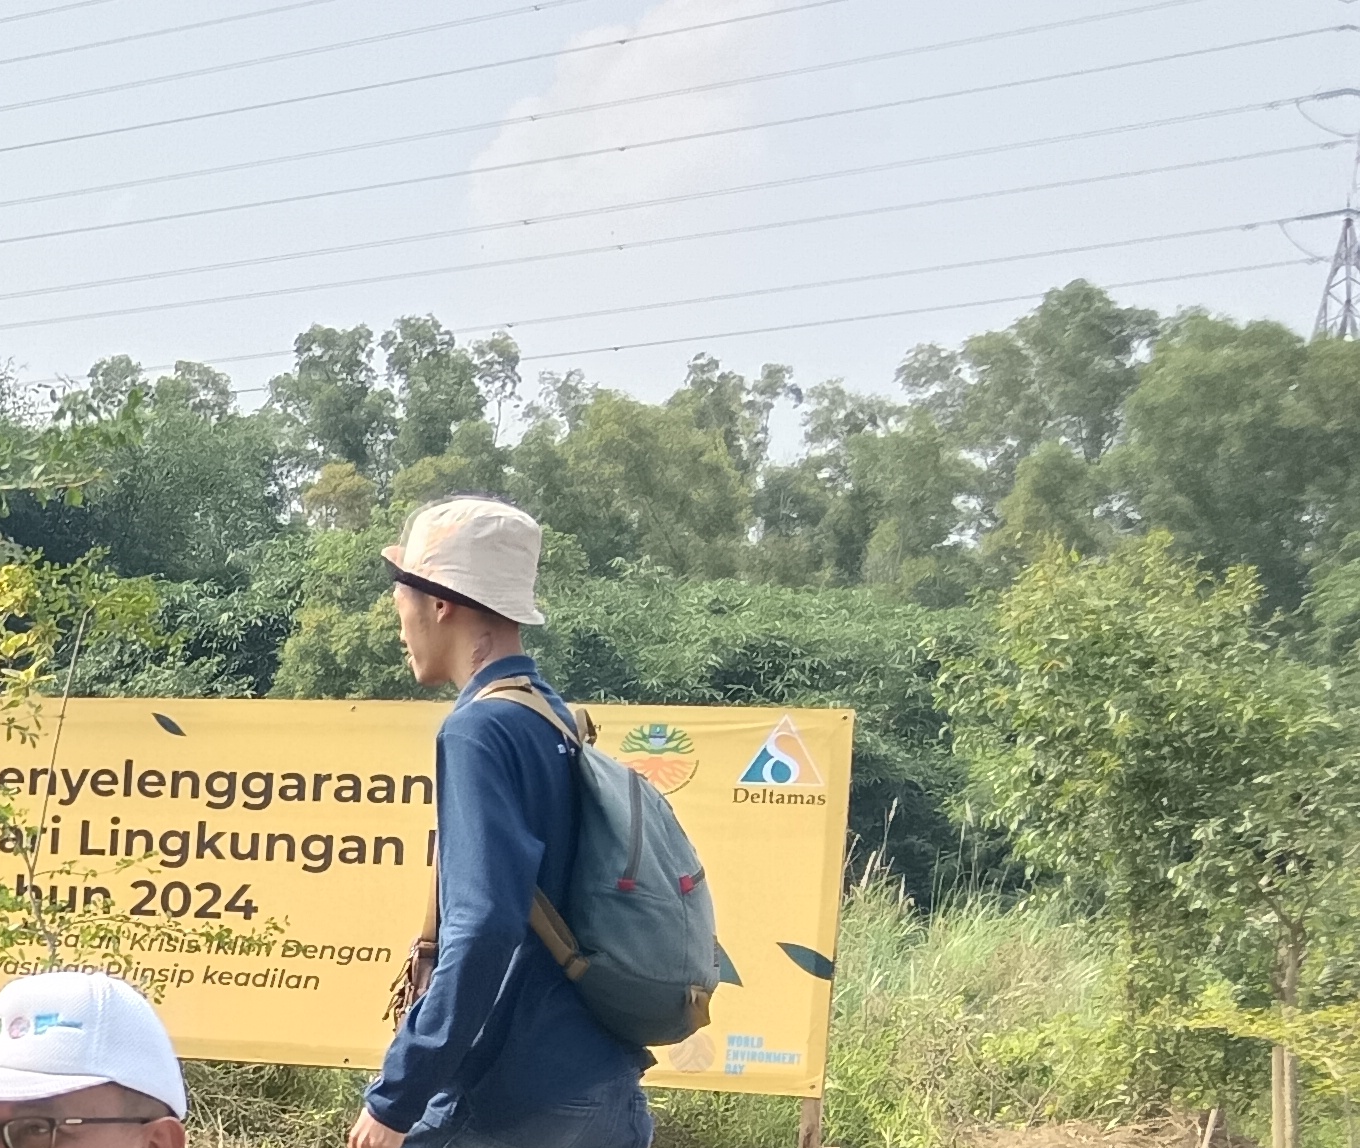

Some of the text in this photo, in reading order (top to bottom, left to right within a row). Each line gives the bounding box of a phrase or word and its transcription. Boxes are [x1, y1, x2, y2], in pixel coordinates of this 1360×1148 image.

[732, 787, 827, 806] Deltamas
[79, 815, 405, 874] Lingkungan
[129, 878, 259, 921] 2024
[281, 938, 392, 966] Dengan
[105, 960, 195, 988] Prinsip
[202, 964, 321, 991] keadilan
[726, 1034, 764, 1049] WORLD
[725, 1048, 802, 1065] ENVIRONMENT
